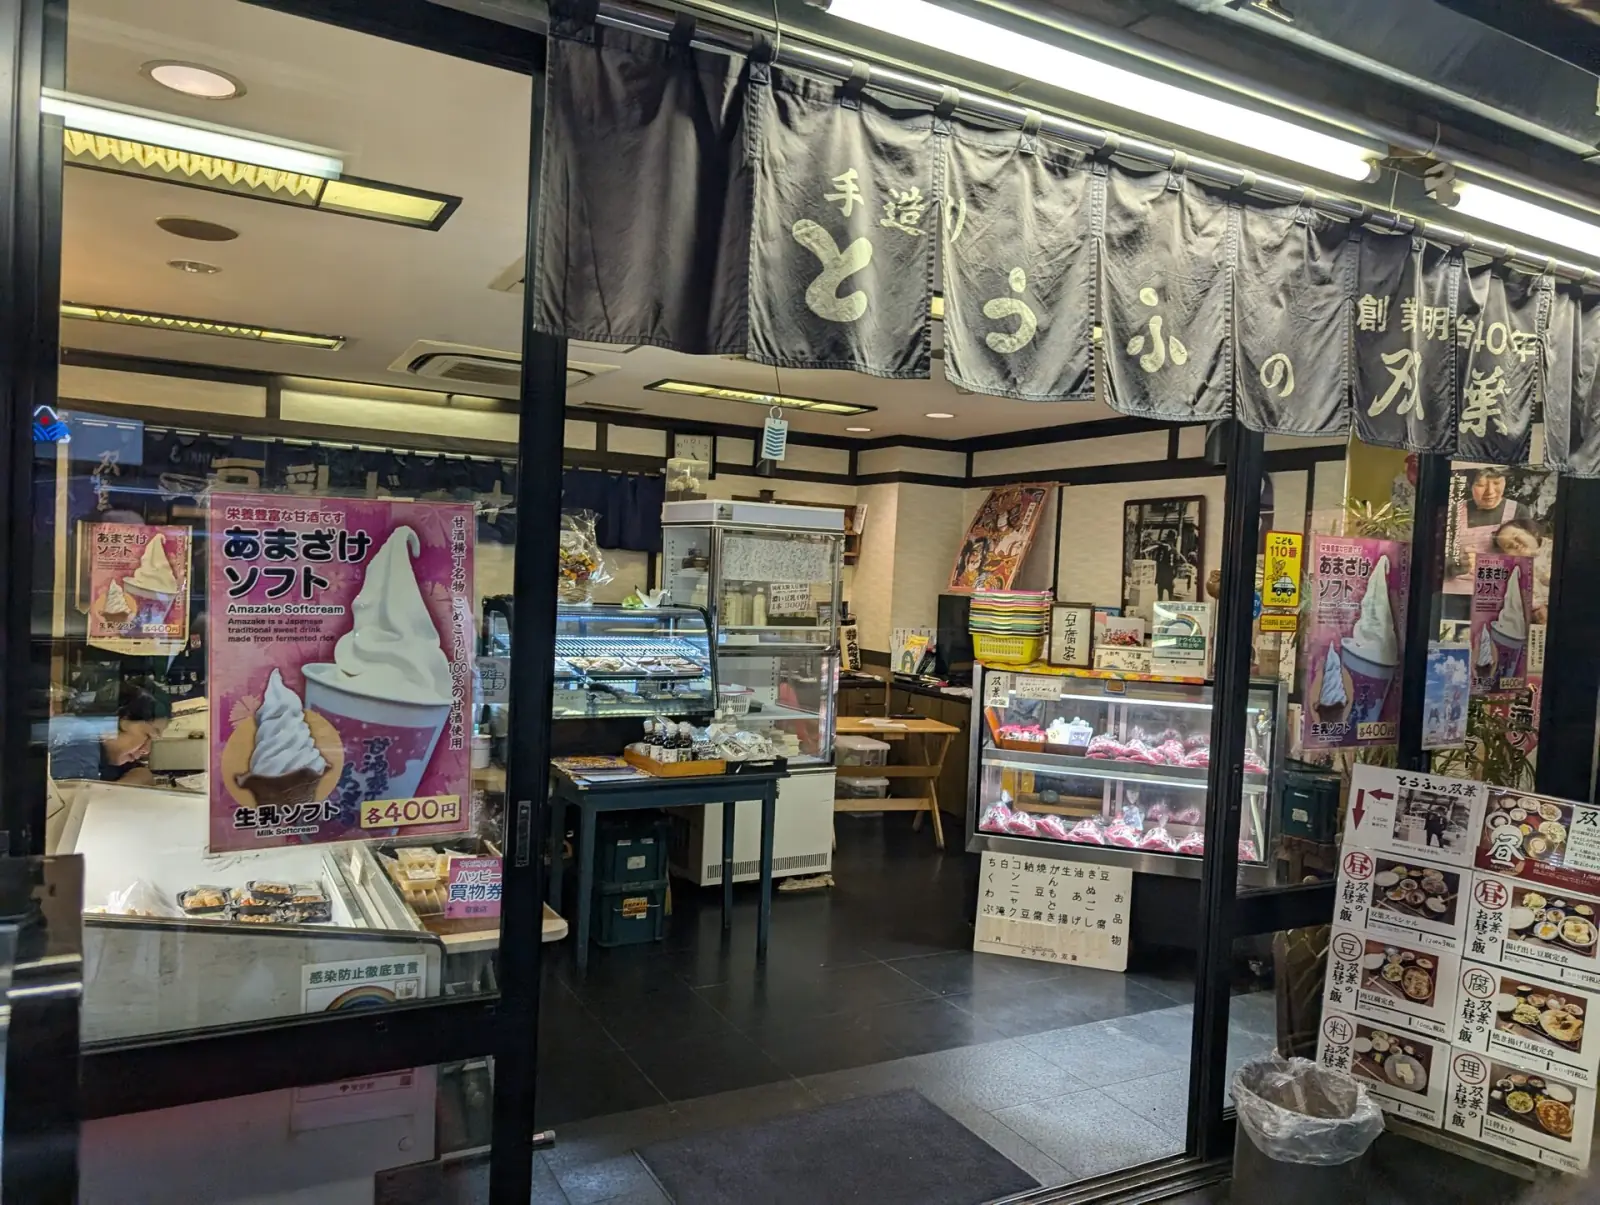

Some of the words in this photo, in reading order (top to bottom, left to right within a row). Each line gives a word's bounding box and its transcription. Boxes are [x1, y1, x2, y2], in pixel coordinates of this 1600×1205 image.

[824, 168, 966, 243] 手造り
[226, 508, 344, 524] 栄養豊富な甘酒です
[97, 532, 147, 545] あまざけ
[224, 526, 371, 563] あまざけ
[1275, 536, 1293, 545] こども
[98, 546, 133, 556] ソフト
[452, 516, 466, 592] 甘酒横丁名物
[1270, 546, 1297, 558] 110番
[1319, 555, 1371, 577] あまざけ
[1477, 566, 1509, 580] あまざけ
[224, 565, 329, 599] ソフト
[1319, 579, 1353, 599] ソフト
[1477, 582, 1499, 594] ソフト
[228, 605, 281, 615] Amazake
[284, 605, 344, 615] Softcream
[228, 626, 271, 634] traditional
[285, 618, 323, 626] Japanese
[254, 635, 273, 643] from
[276, 635, 317, 643] fermented
[448, 598, 467, 749] こめこうじ100%の甘酒使用
[1311, 722, 1351, 735] 生乳ソフト
[1359, 723, 1396, 737] 各400円
[1396, 775, 1478, 798] とうふの双葉
[234, 804, 340, 827] 生乳ソフト
[365, 799, 457, 824] 各400円
[256, 828, 274, 837] Milk
[276, 825, 318, 835] Softcream
[1485, 833, 1525, 869] 昼
[456, 869, 501, 883] ハッピー
[1346, 854, 1370, 878] 昼
[450, 884, 502, 901] 買物券
[1340, 880, 1354, 922] お昼ご飯
[1355, 882, 1369, 912] 双葉の
[1479, 882, 1504, 907] 昼
[1371, 911, 1419, 926] 双葉スペシャル
[1488, 912, 1503, 943] 双葉の
[1471, 909, 1489, 954] お昼ご飯
[1338, 937, 1357, 957] 豆
[1505, 942, 1568, 964] 揚げ出し豆腐定食
[309, 961, 420, 985] 感染防止徹底宣言
[1329, 960, 1344, 1004] お昼ご飯
[1345, 963, 1359, 993] 双葉の
[1468, 973, 1489, 994] 腐
[1458, 997, 1476, 1043] お昼ご飯
[1475, 1000, 1492, 1033] 双葉の
[1329, 1020, 1348, 1041] 料
[1492, 1032, 1555, 1057] 焼き揚げ豆腐定食
[1460, 1058, 1480, 1080] 理
[1452, 1083, 1467, 1128] お昼ご飯
[1468, 1086, 1484, 1118] 双葉の
